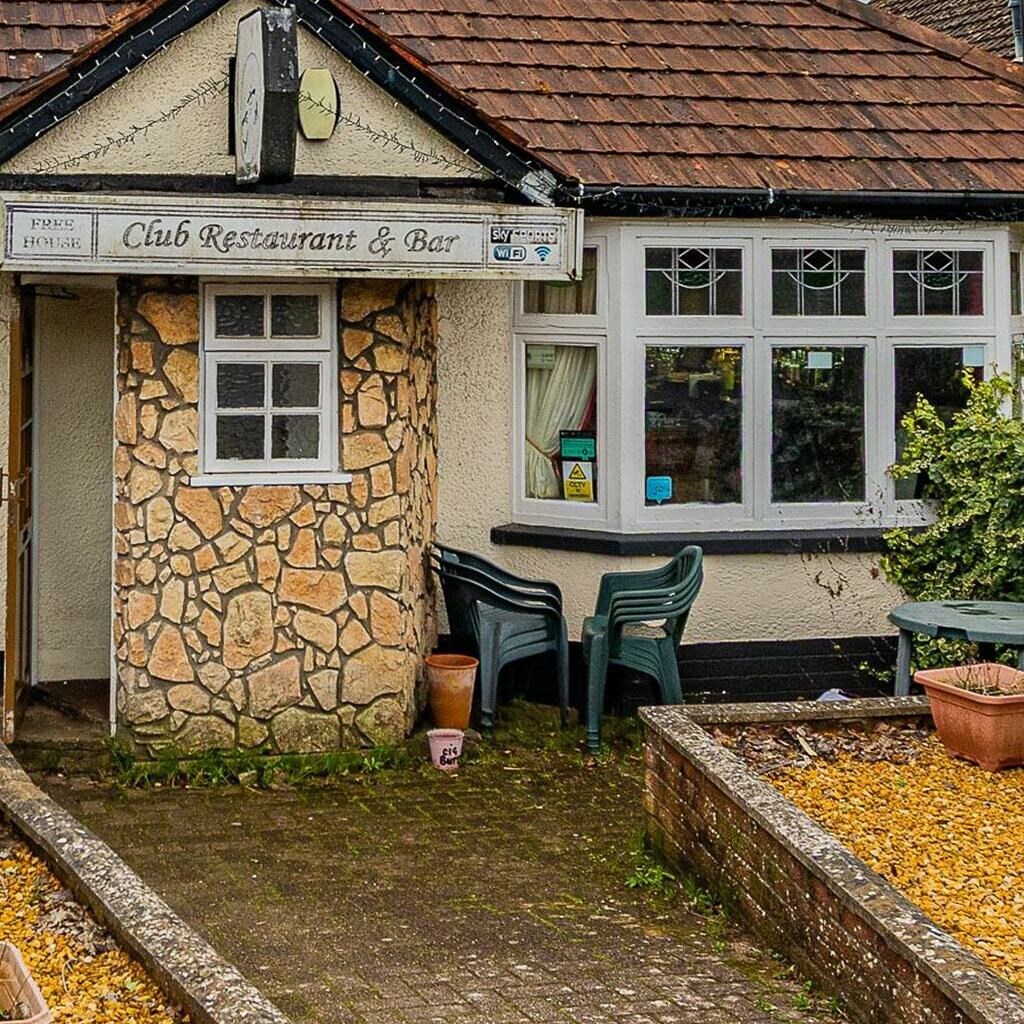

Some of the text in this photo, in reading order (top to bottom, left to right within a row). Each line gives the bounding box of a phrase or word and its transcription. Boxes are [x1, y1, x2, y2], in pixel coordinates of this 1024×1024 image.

[31, 218, 74, 231] FREE
[23, 236, 81, 249] HOUSE
[122, 219, 460, 258] Club Restaurant & Bar
[512, 229, 555, 243] SPORTS
